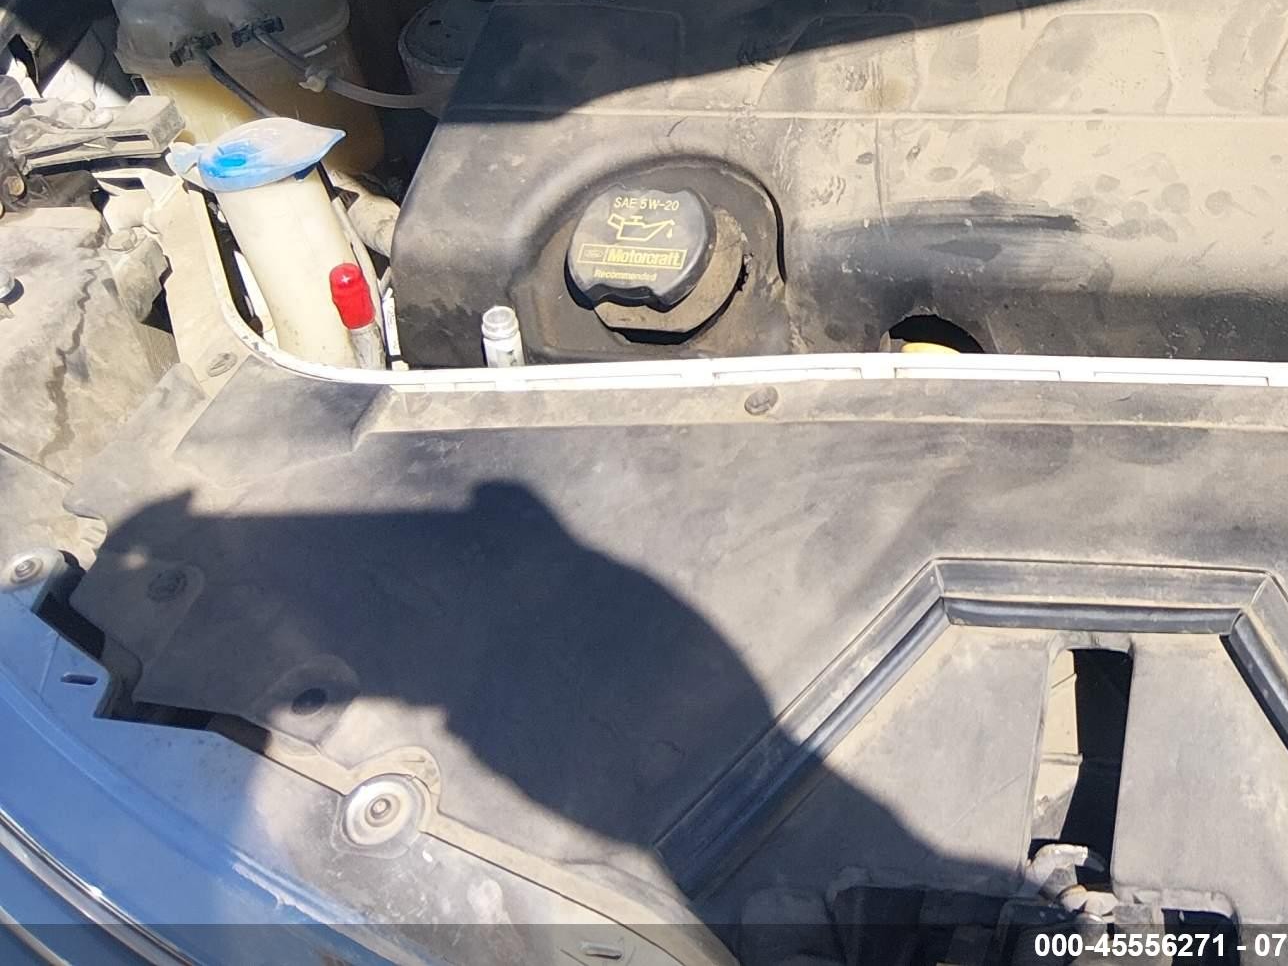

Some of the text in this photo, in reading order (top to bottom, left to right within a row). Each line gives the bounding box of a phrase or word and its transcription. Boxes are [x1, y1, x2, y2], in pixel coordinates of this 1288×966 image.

[613, 196, 681, 212] SAE 5W-20
[607, 248, 681, 267] Motorcraft
[593, 269, 658, 282] Recommended
